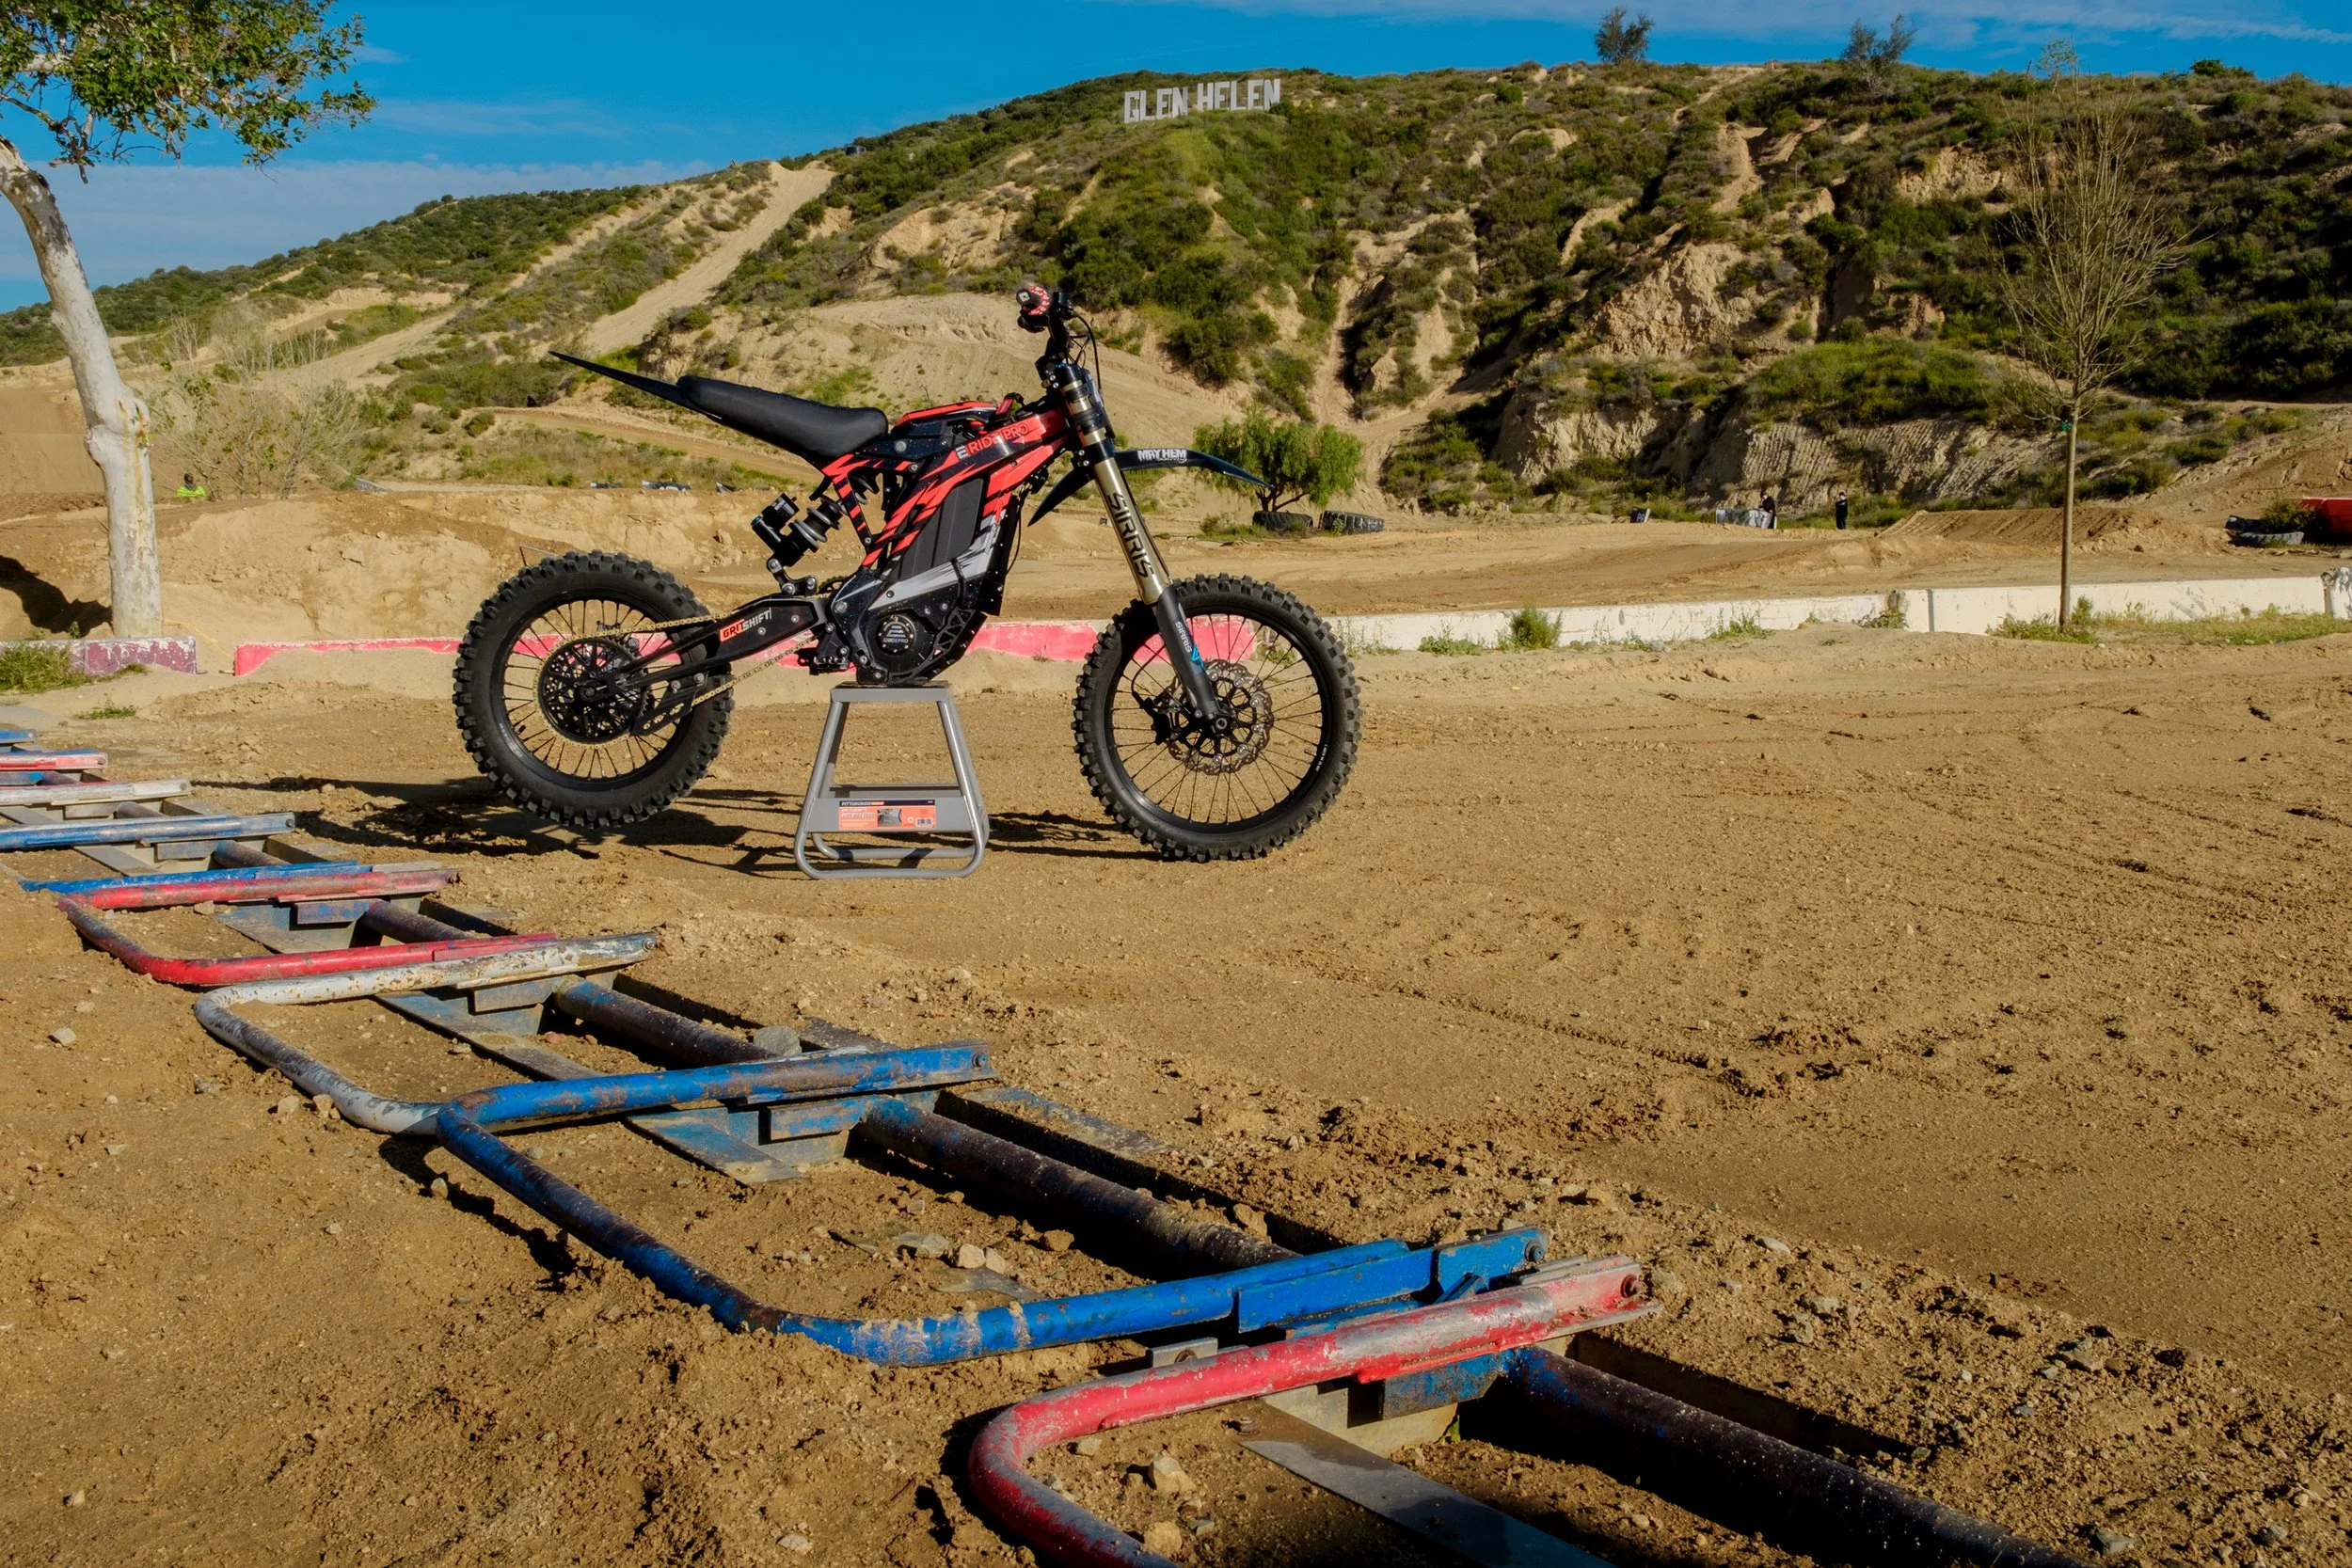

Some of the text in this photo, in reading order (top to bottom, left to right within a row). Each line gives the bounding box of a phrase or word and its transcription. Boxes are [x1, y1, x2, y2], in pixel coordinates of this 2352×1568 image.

[1123, 78, 1281, 123] GLEN HELEN
[1001, 423, 1028, 440] PRO
[1106, 492, 1154, 578] SIRRIS
[1175, 621, 1193, 653] SIRRIS
